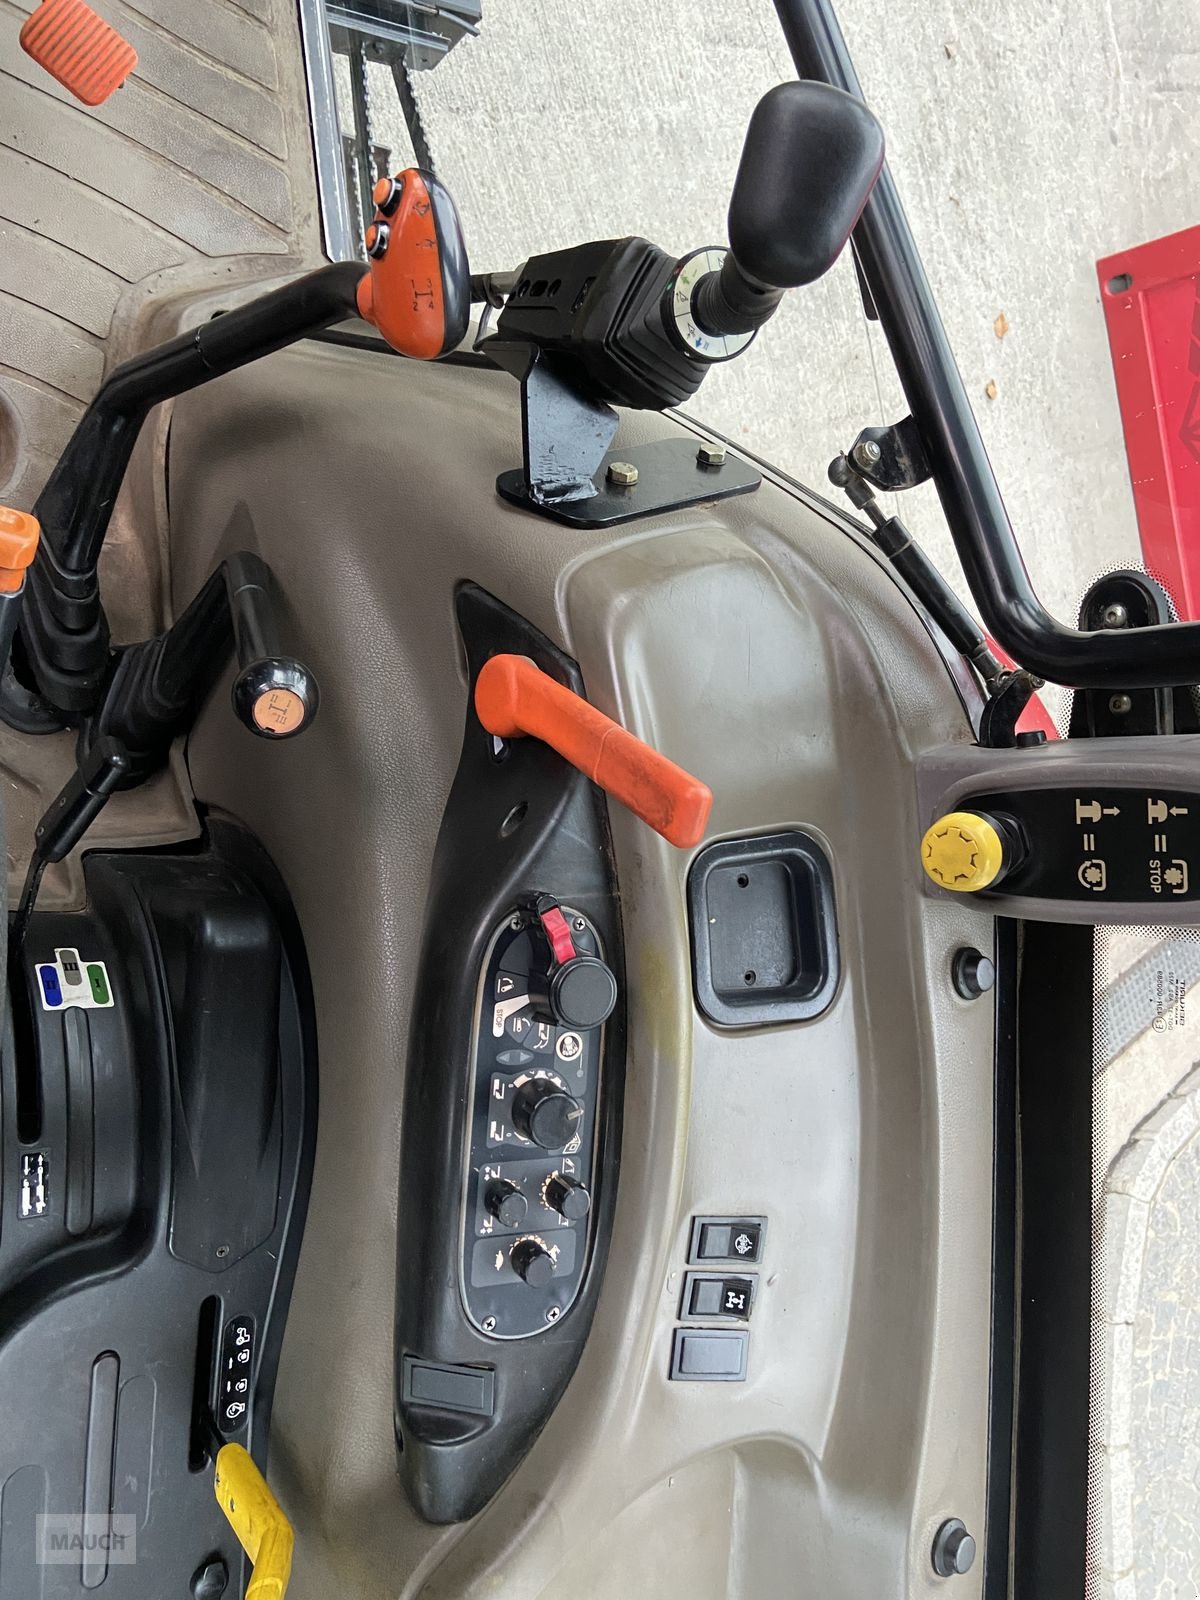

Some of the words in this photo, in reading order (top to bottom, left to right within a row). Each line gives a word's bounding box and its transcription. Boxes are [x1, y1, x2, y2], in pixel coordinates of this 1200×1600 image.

[411, 279, 415, 289] 1
[426, 278, 432, 288] 3
[412, 301, 418, 311] 2
[428, 301, 434, 310] 4
[1149, 859, 1162, 894] STOP
[62, 962, 80, 972] III
[46, 980, 57, 990] II
[495, 1008, 504, 1028] STOP
